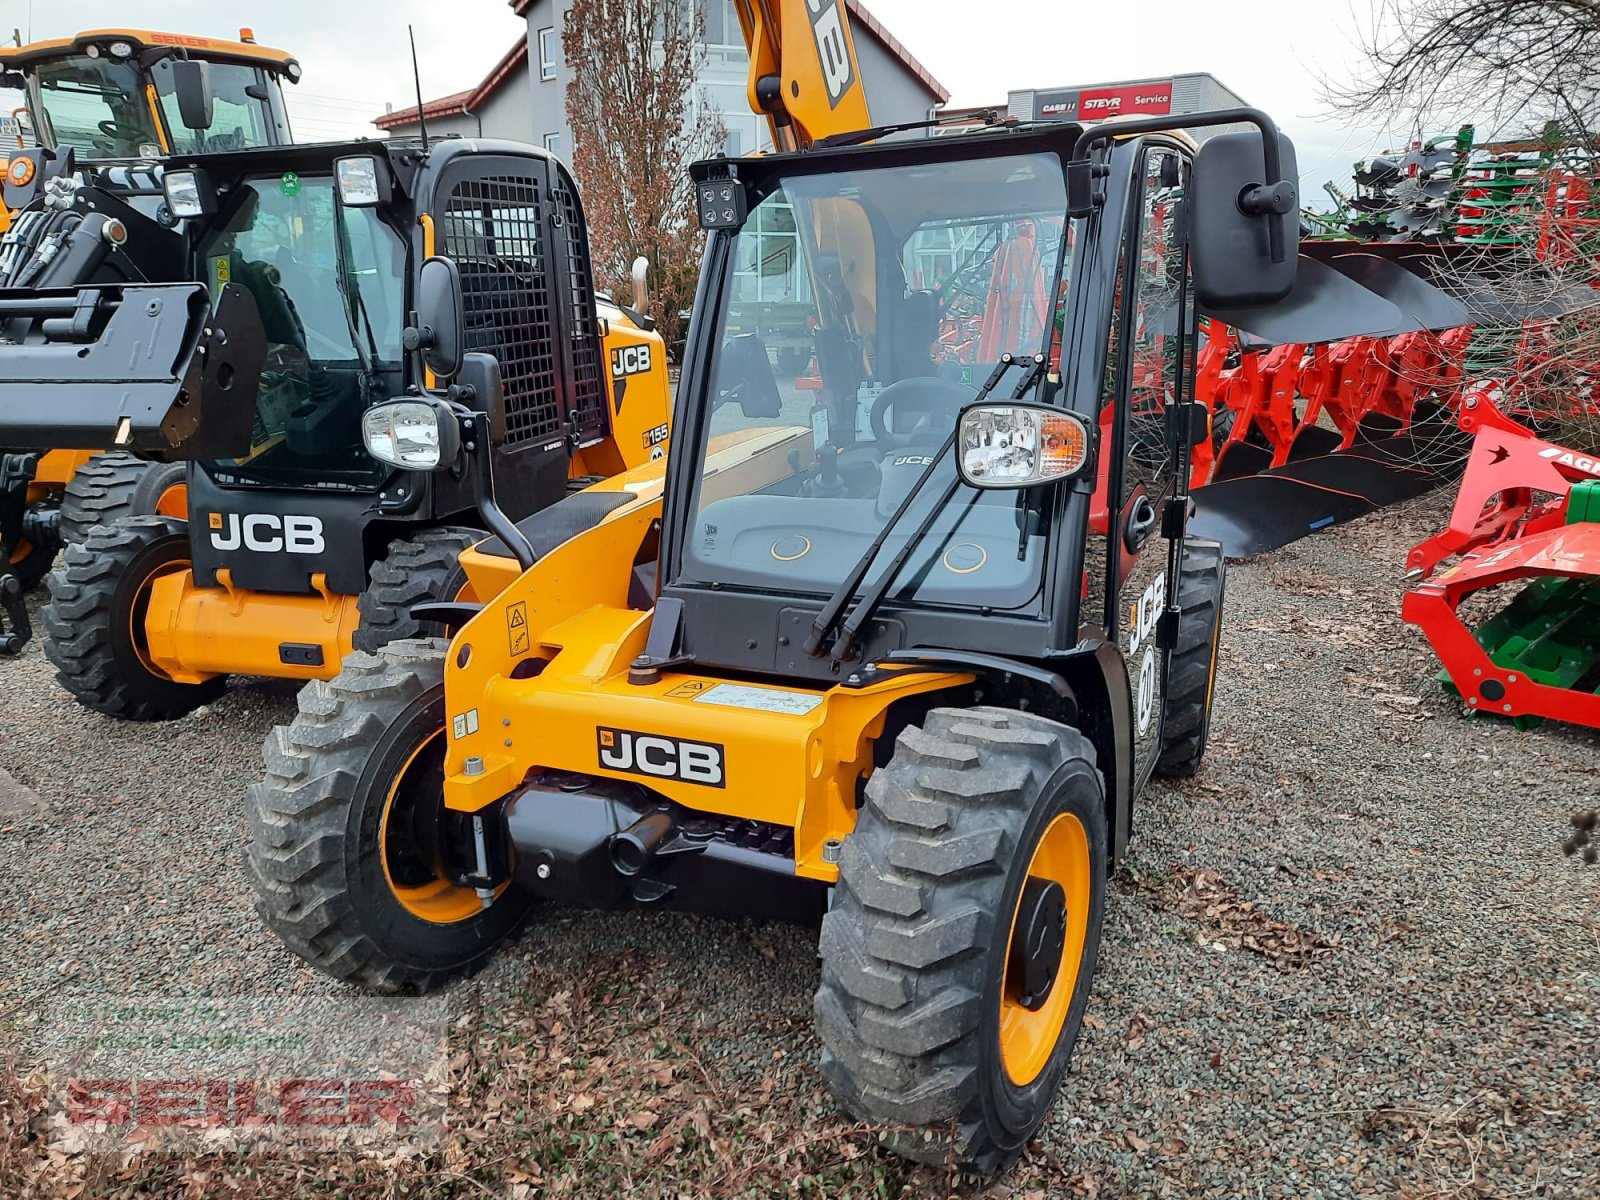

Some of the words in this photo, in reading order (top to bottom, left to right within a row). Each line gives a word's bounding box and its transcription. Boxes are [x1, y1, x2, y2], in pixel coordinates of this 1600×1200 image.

[151, 34, 208, 47] SEILER
[1042, 103, 1066, 112] CASE
[1083, 97, 1121, 109] STEYR
[1134, 95, 1169, 105] Service
[612, 345, 651, 376] JCB
[649, 424, 669, 444] 155
[210, 513, 325, 554] JCB
[1130, 571, 1165, 656] JCB
[1140, 662, 1152, 720] 20
[601, 733, 722, 784] JCB
